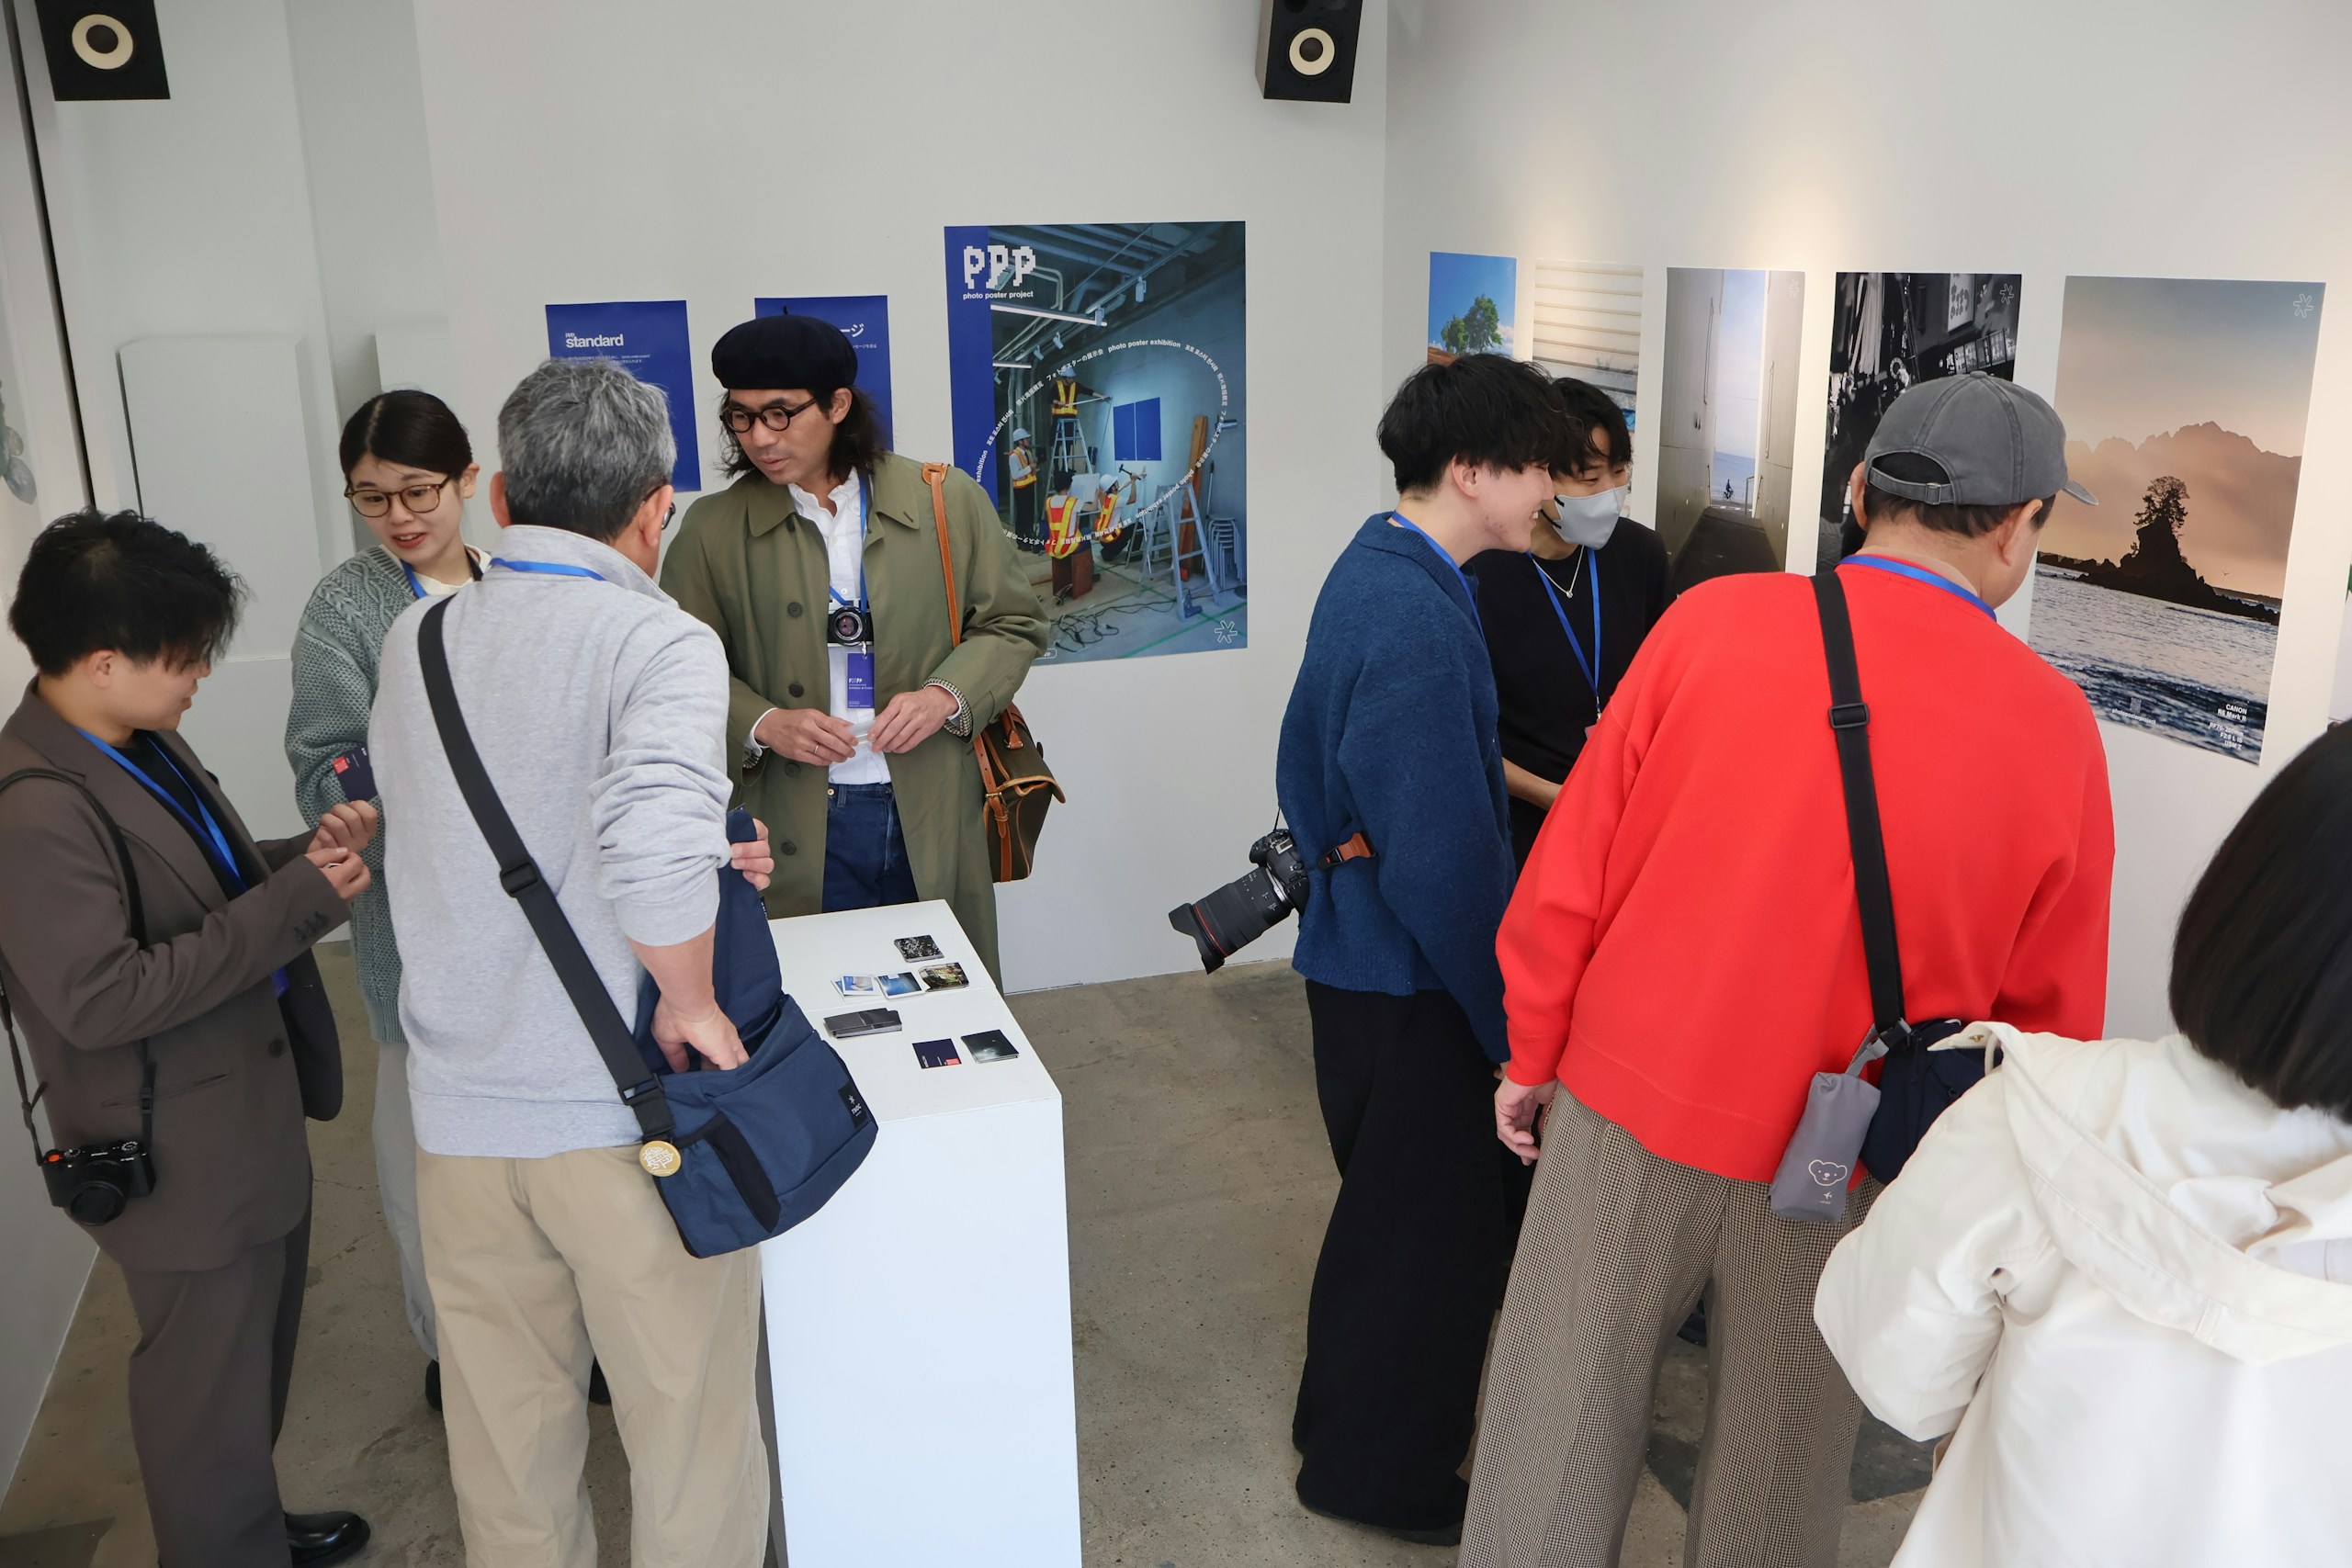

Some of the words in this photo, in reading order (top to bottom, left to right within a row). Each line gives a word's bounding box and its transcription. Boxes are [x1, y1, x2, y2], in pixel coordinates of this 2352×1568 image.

[963, 292, 983, 300] photo
[985, 291, 1008, 299] poster
[1009, 290, 1034, 299] project
[566, 333, 624, 348] standard
[1108, 343, 1126, 354] photo
[1128, 339, 1148, 348] poster
[1149, 339, 1182, 348] exhibition
[976, 450, 989, 483] exhibition
[1179, 468, 1194, 486] photo
[1163, 483, 1181, 501] poster
[1135, 498, 1163, 518] exhibition
[2225, 704, 2248, 715] CANON
[2225, 711, 2241, 720] Mark
